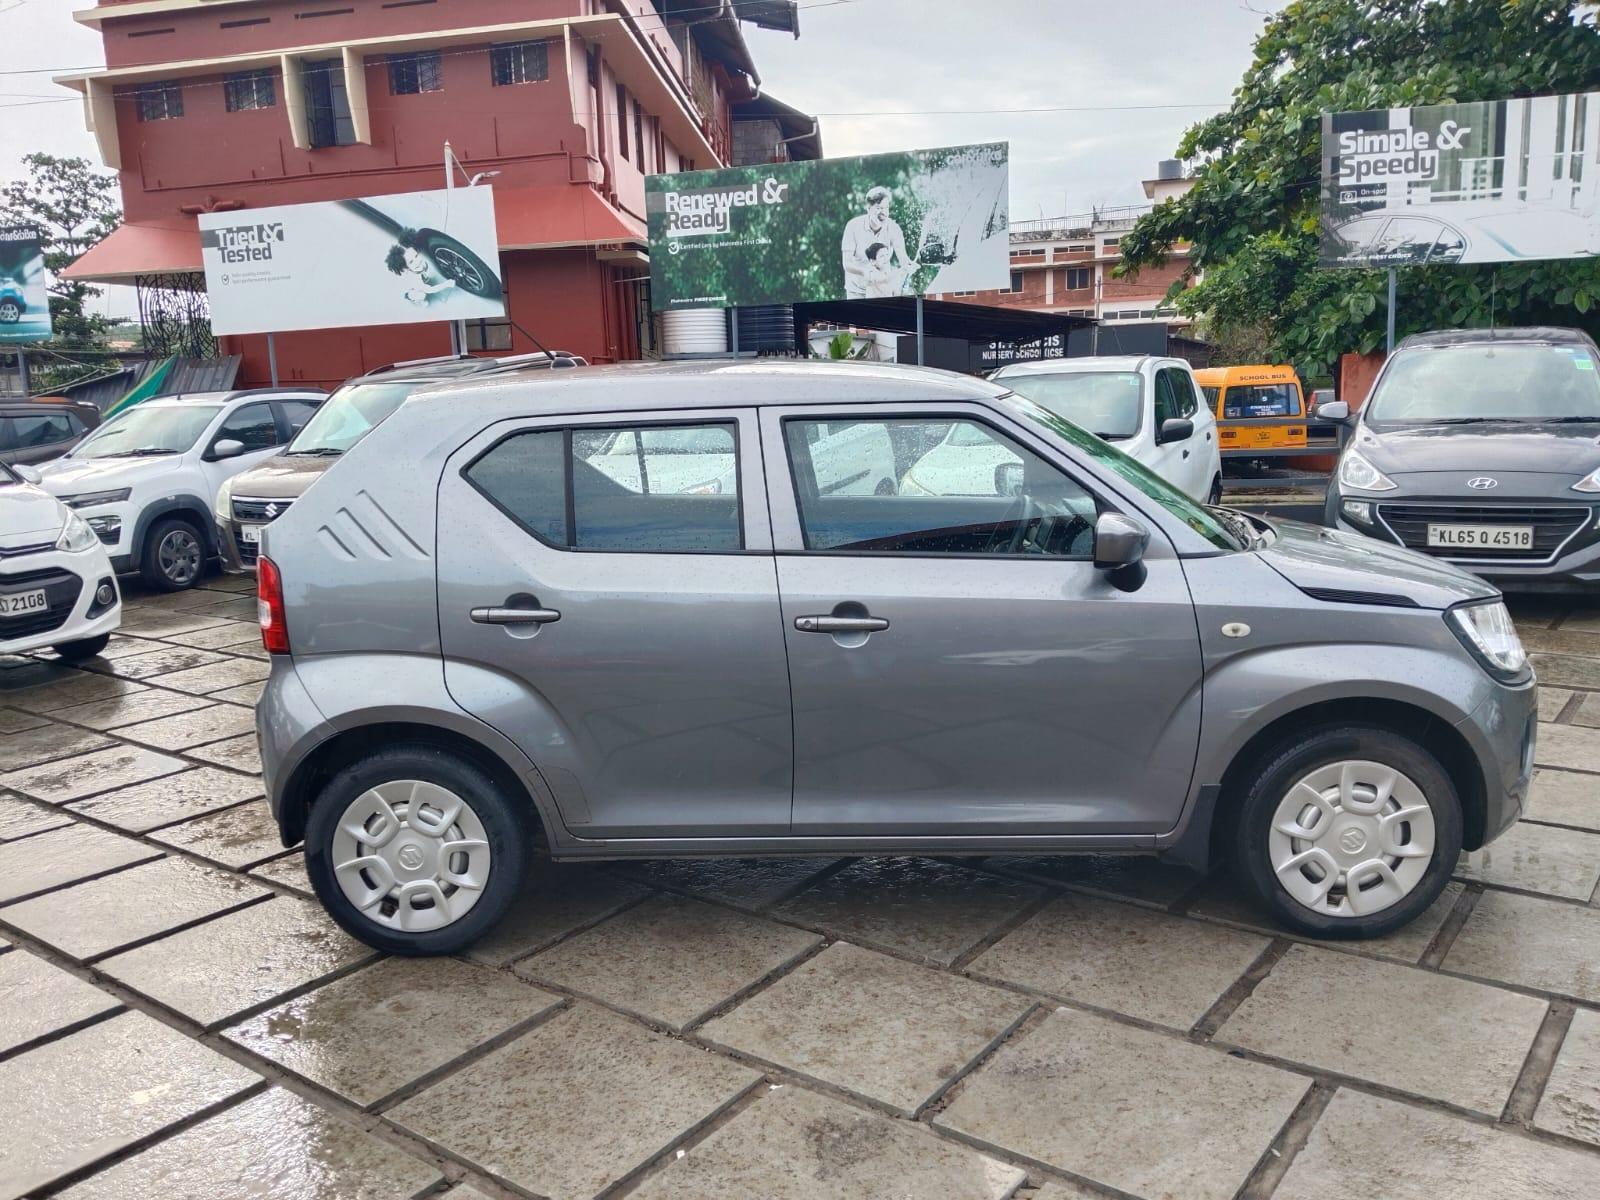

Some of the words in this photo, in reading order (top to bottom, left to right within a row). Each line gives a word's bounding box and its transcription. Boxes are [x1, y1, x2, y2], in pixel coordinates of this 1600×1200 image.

[1340, 126, 1429, 155] Simple
[1436, 120, 1471, 150] &
[1340, 150, 1435, 182] Speedy
[665, 184, 757, 211] Renewed
[762, 178, 788, 204] &
[667, 207, 728, 232] Ready
[215, 225, 259, 248] Tried
[217, 242, 272, 263] Tested
[1440, 530, 1475, 543] KL65
[1493, 531, 1530, 545] 4518
[11, 593, 44, 611] 2108
